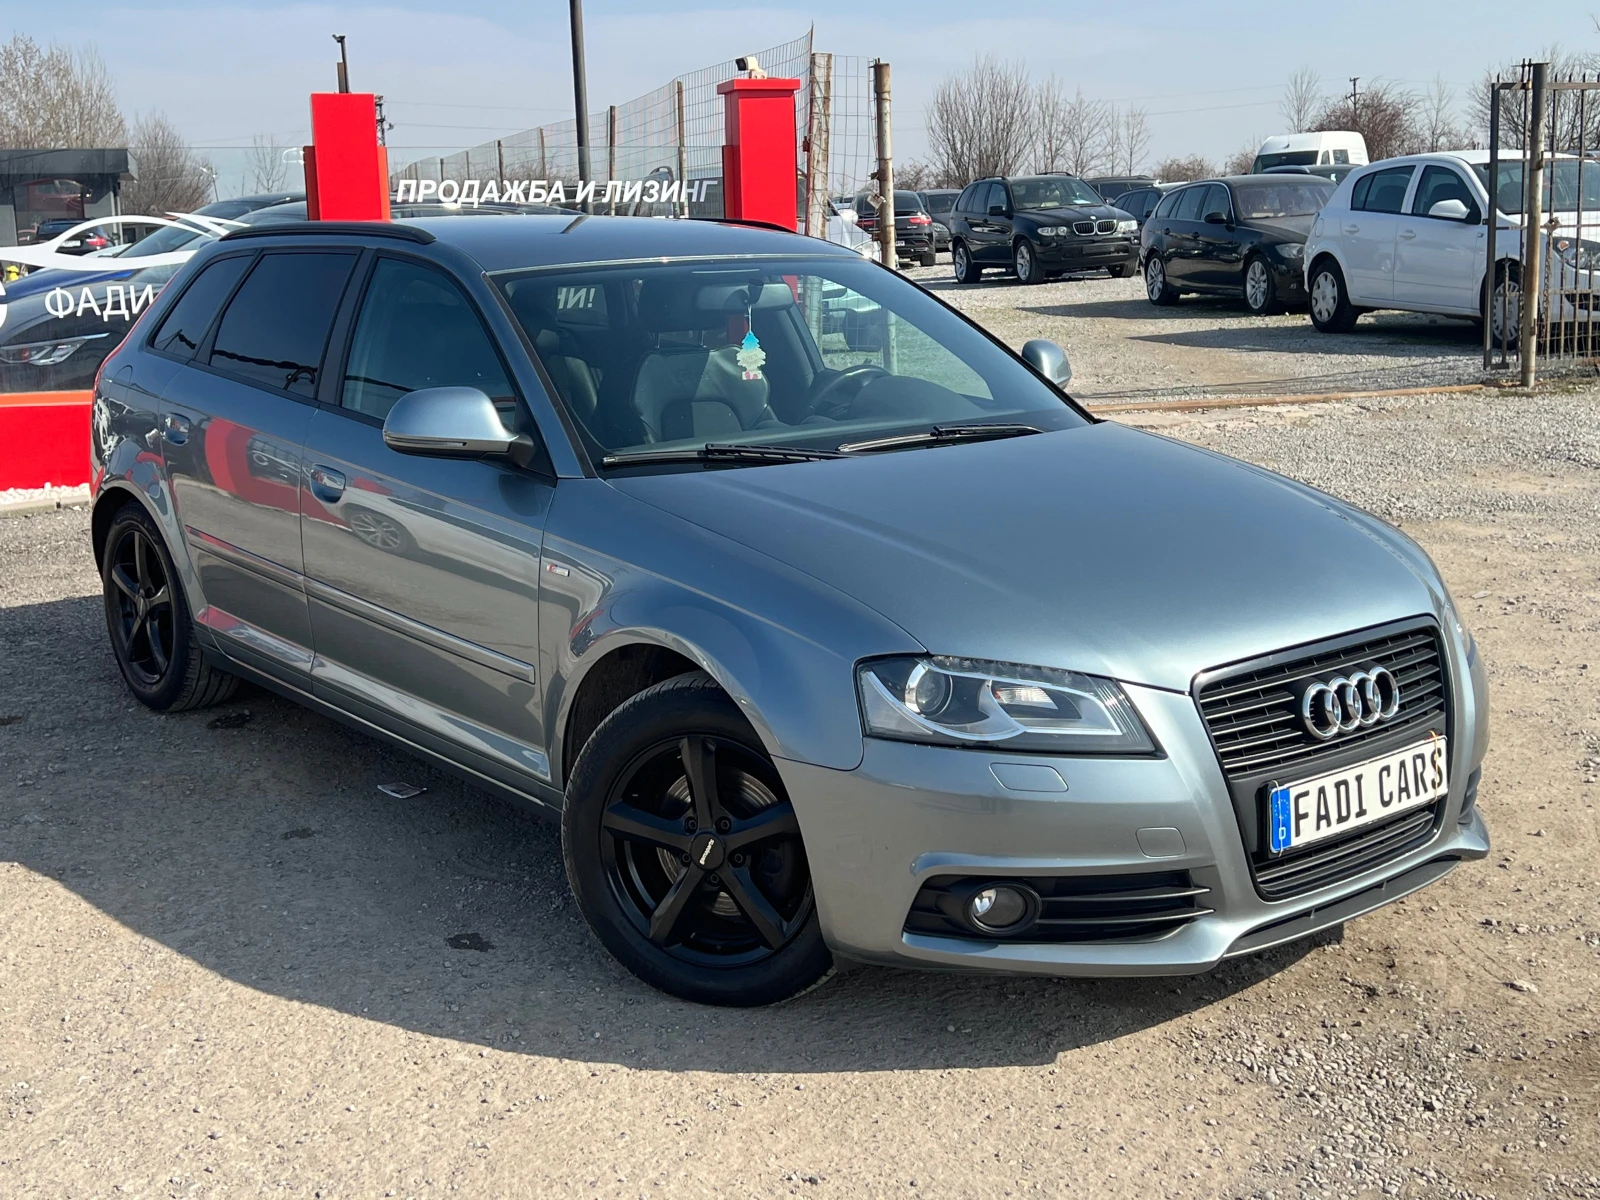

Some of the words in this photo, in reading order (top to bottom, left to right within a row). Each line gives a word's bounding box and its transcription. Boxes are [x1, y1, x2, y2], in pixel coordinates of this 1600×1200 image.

[396, 179, 566, 208] ПРОДАЖБА
[576, 180, 596, 203] И
[601, 180, 718, 203] ЛИЗИНГ
[44, 284, 156, 322] ФАДИ
[1293, 773, 1368, 838] FADI
[1378, 747, 1443, 808] CARS
